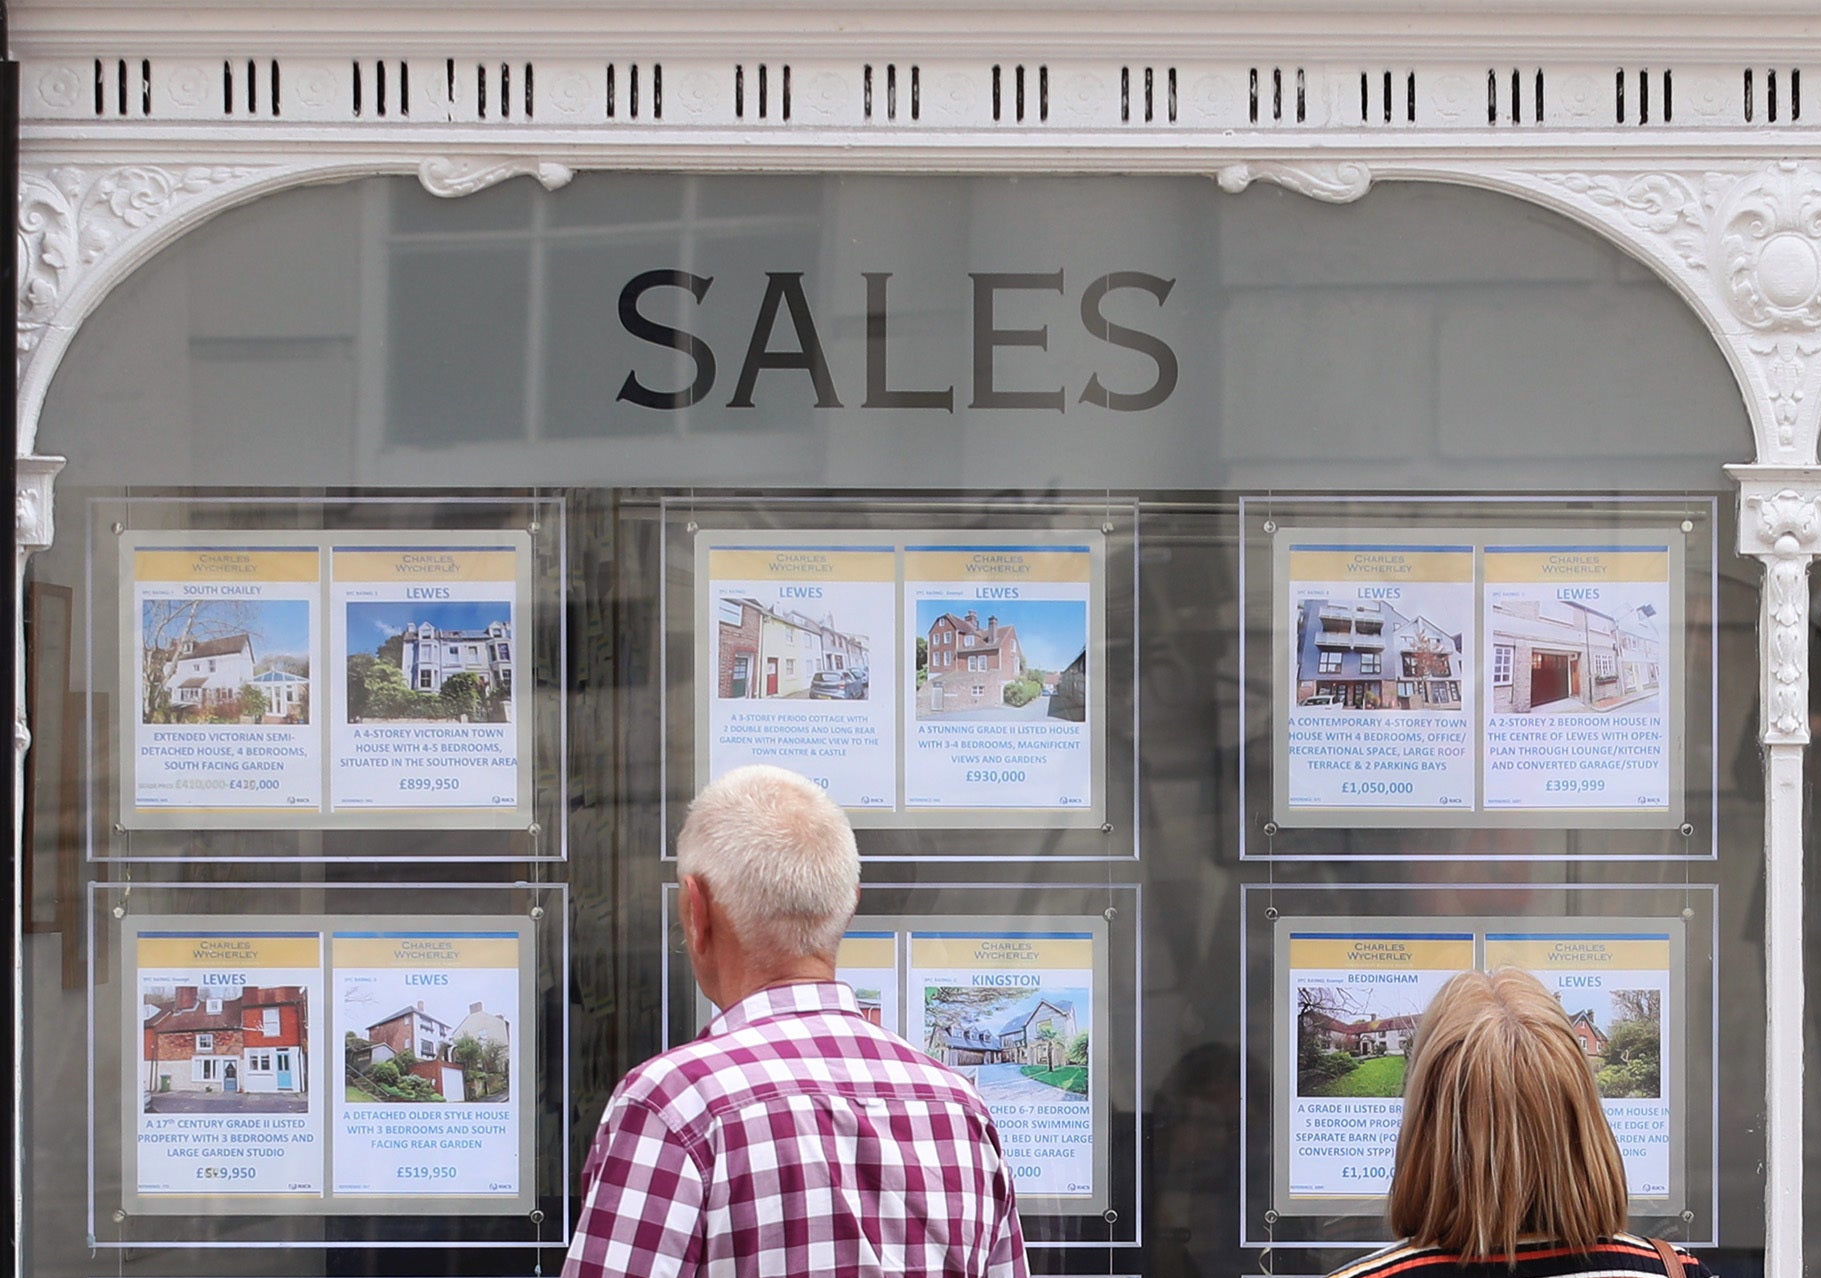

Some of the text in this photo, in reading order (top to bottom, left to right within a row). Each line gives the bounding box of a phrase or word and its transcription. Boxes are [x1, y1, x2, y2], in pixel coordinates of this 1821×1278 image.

[615, 268, 1178, 415] SALES
[183, 585, 261, 595] SOUTH CHAILEY
[406, 588, 450, 599] LEWES
[780, 587, 822, 598] LEWES
[976, 588, 1019, 598] LEWES
[1358, 588, 1400, 599] LEWES
[1557, 588, 1599, 599] LEWES
[354, 729, 503, 738] A 4-STOREY VICTORIAN TOWN
[165, 761, 284, 770] SOUTH FACING GARDEN
[966, 771, 1025, 784] £930,000
[400, 778, 459, 791] £899,950
[1342, 782, 1413, 795] £1,050,000
[1546, 780, 1605, 793] £399,999
[978, 942, 1032, 950] CHARLES
[1354, 944, 1406, 952] CHARLES
[974, 951, 1039, 960] WYCHERLEY
[1347, 952, 1412, 960] WYCHERLEY
[203, 974, 246, 985] LEWES
[405, 974, 448, 985] LEWES
[972, 975, 1040, 986] KINGSTON
[1348, 974, 1418, 983] BEDDINGHAM
[1559, 976, 1601, 987] LEWES
[372, 1140, 482, 1149] FACING REAR GARDEN
[167, 1148, 284, 1157] LARGE GARDEN STUDIO
[1034, 1149, 1075, 1157] GARAGE
[397, 1167, 456, 1180] £519,950
